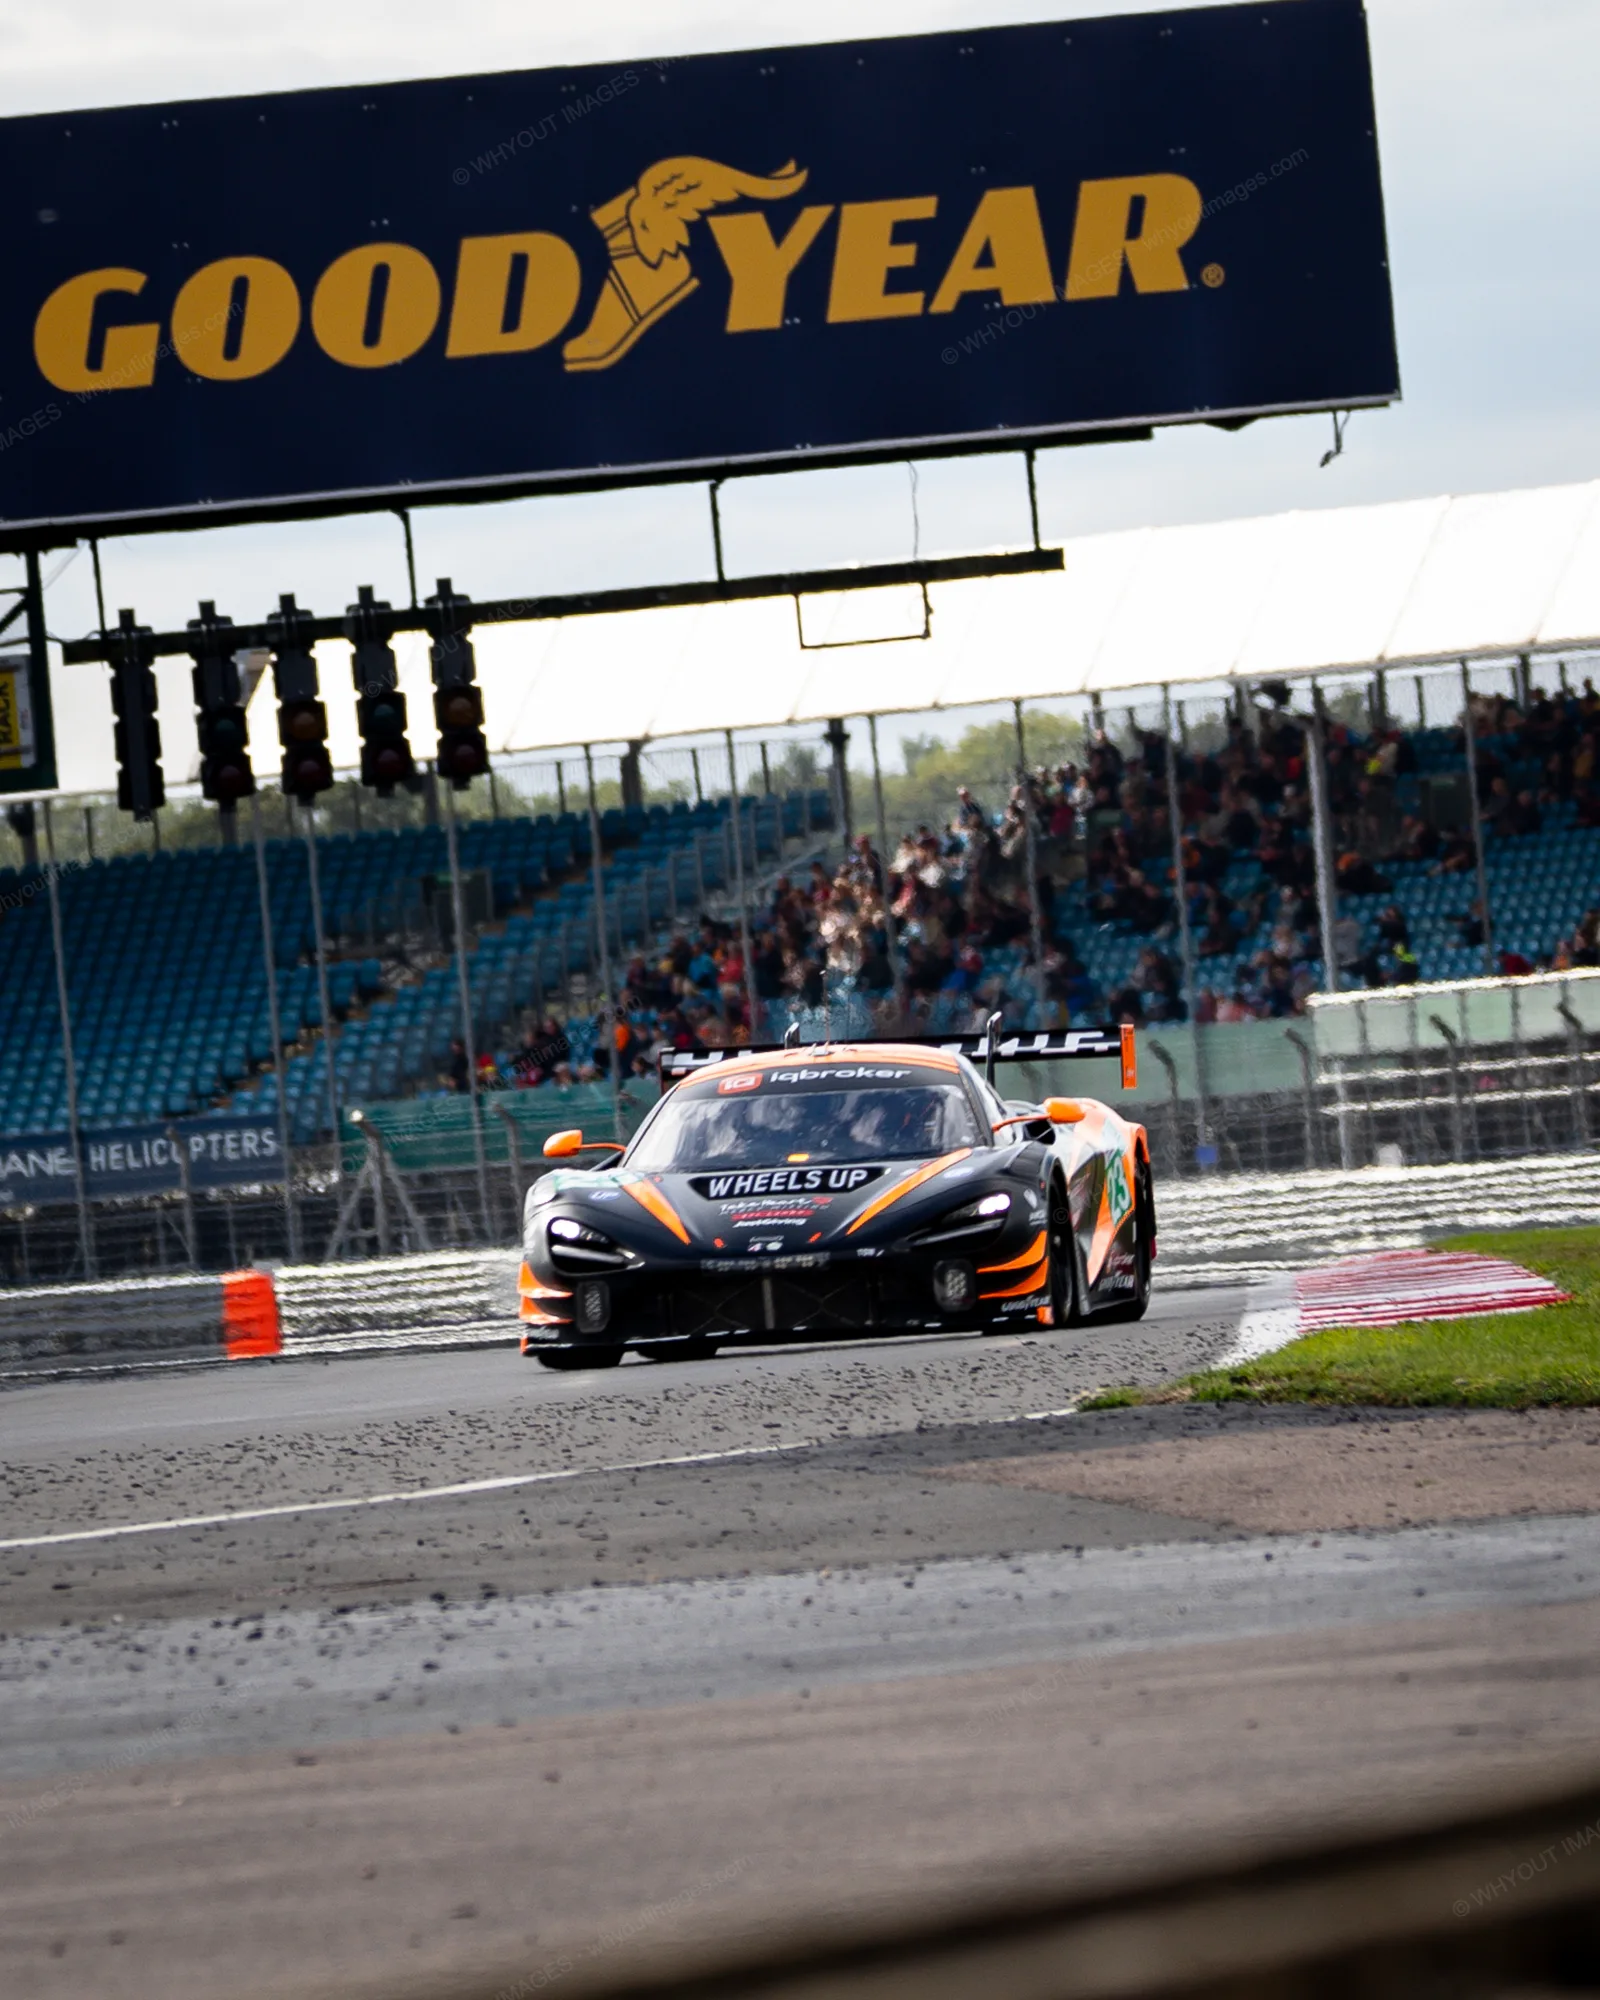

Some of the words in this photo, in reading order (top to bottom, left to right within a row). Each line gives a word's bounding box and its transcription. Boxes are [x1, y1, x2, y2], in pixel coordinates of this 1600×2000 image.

[36, 175, 1201, 391] GOODYEAR
[0, 1146, 77, 1178] ANE
[709, 1170, 823, 1198] WHEELS
[828, 1169, 868, 1189] UP
